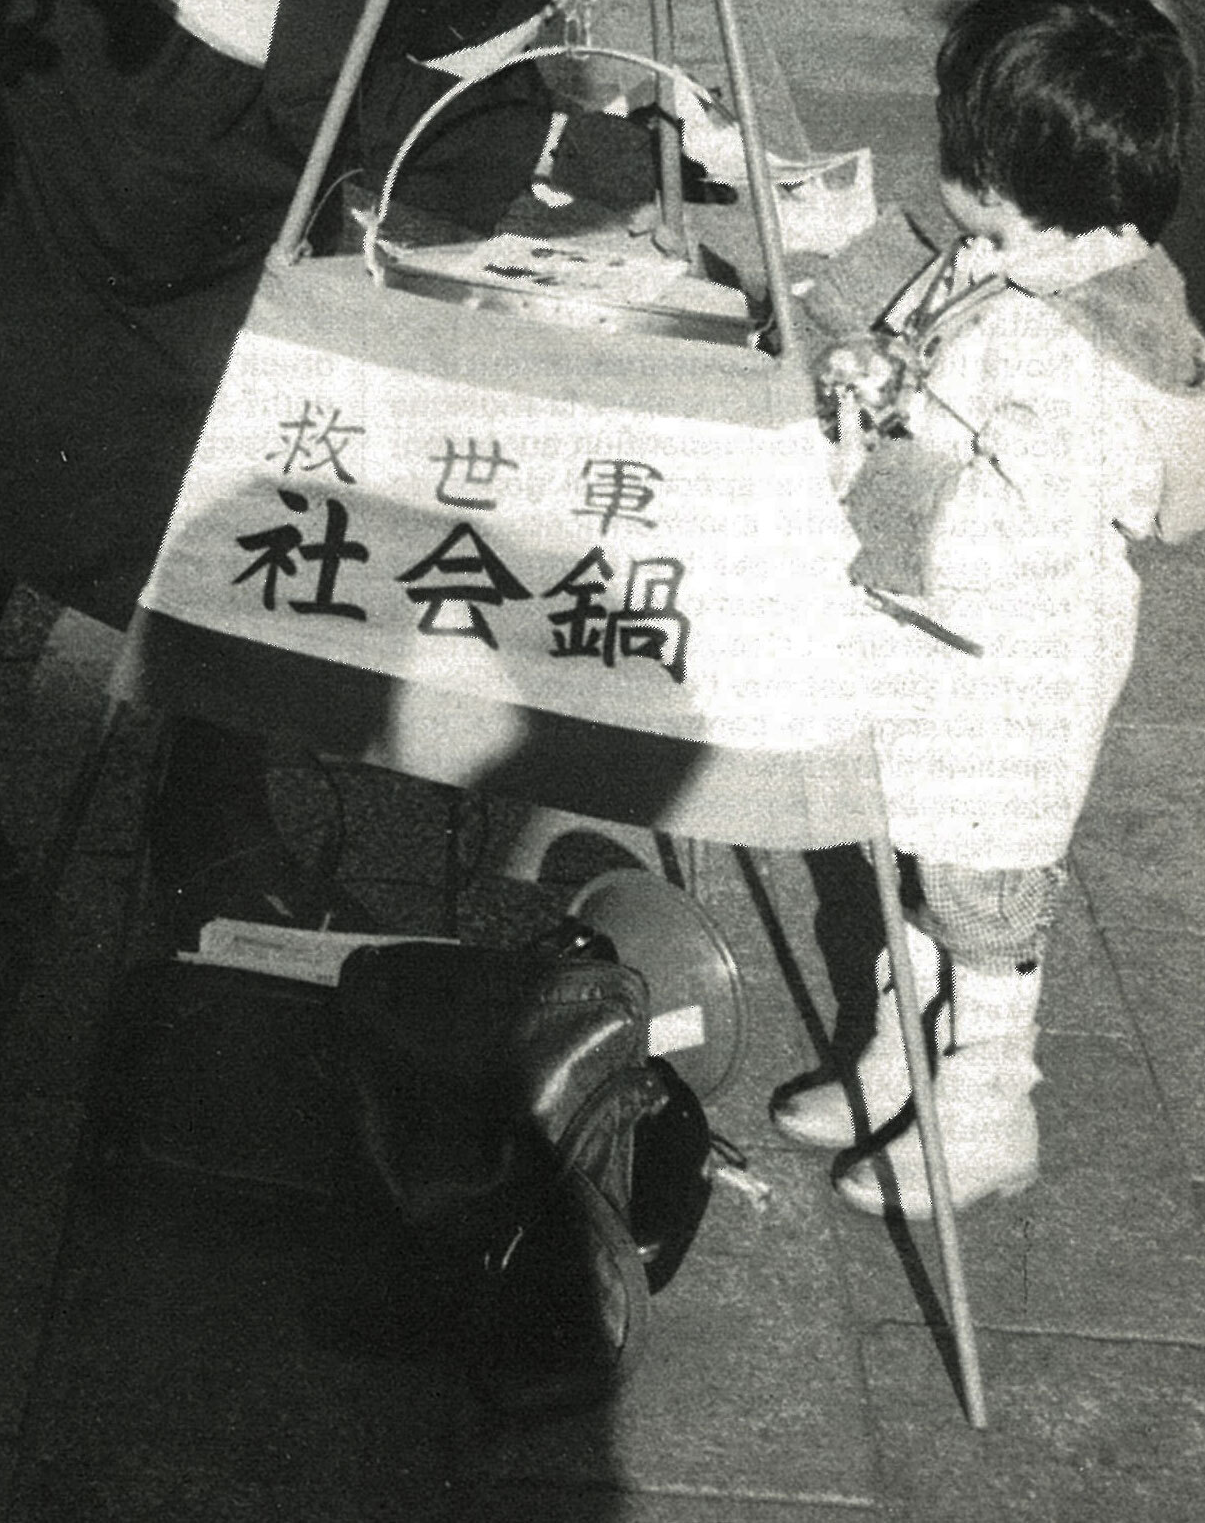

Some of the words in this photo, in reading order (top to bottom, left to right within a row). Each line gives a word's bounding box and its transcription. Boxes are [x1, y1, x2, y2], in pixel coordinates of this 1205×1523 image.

[265, 400, 664, 535] 救世軍
[233, 489, 688, 684] 社会鍋
